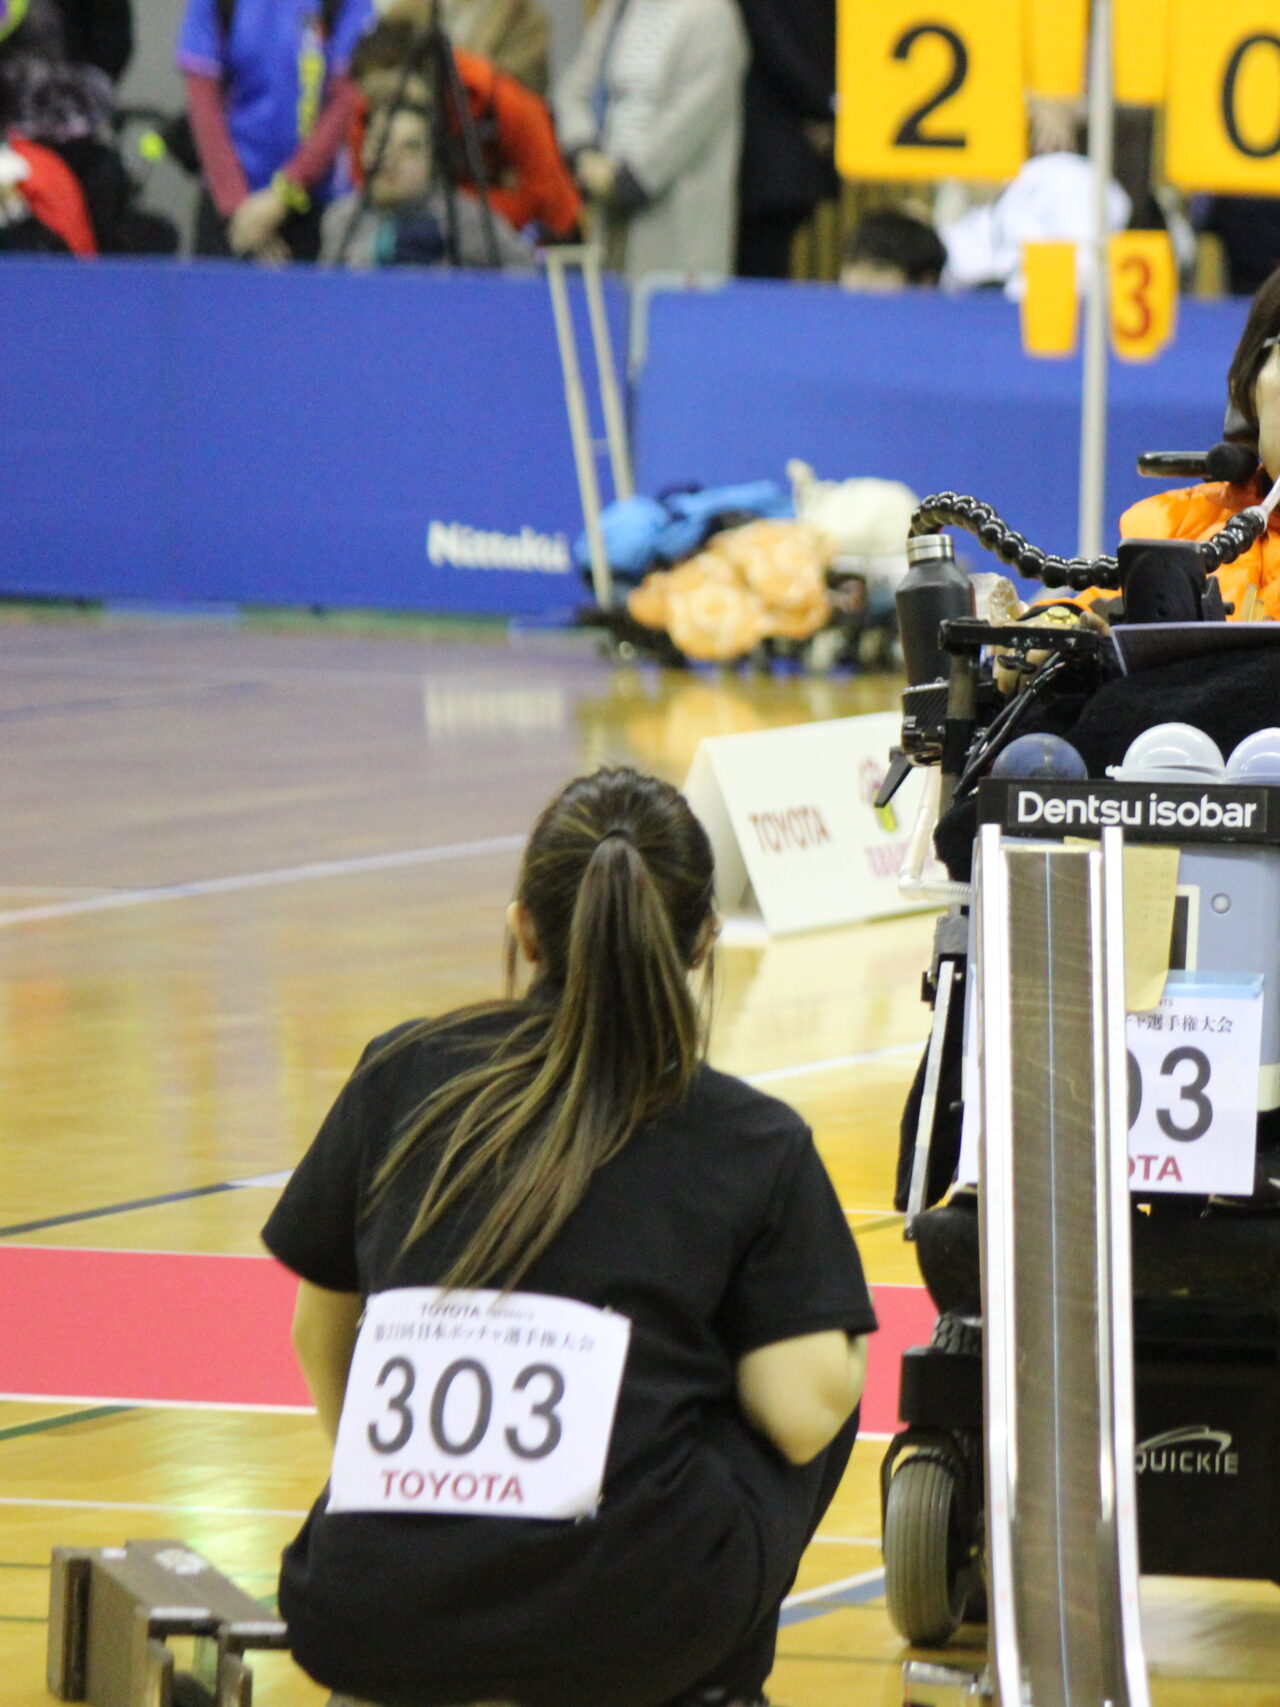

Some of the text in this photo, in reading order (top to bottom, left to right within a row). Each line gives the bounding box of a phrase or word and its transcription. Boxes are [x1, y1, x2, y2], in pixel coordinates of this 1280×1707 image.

[891, 22, 969, 148] 2
[1114, 255, 1153, 340] 3
[749, 805, 831, 855] TOYOTA
[1018, 791, 1257, 827] Dentsu isobar
[367, 1354, 566, 1460] 303
[381, 1470, 524, 1503] TOYOTA
